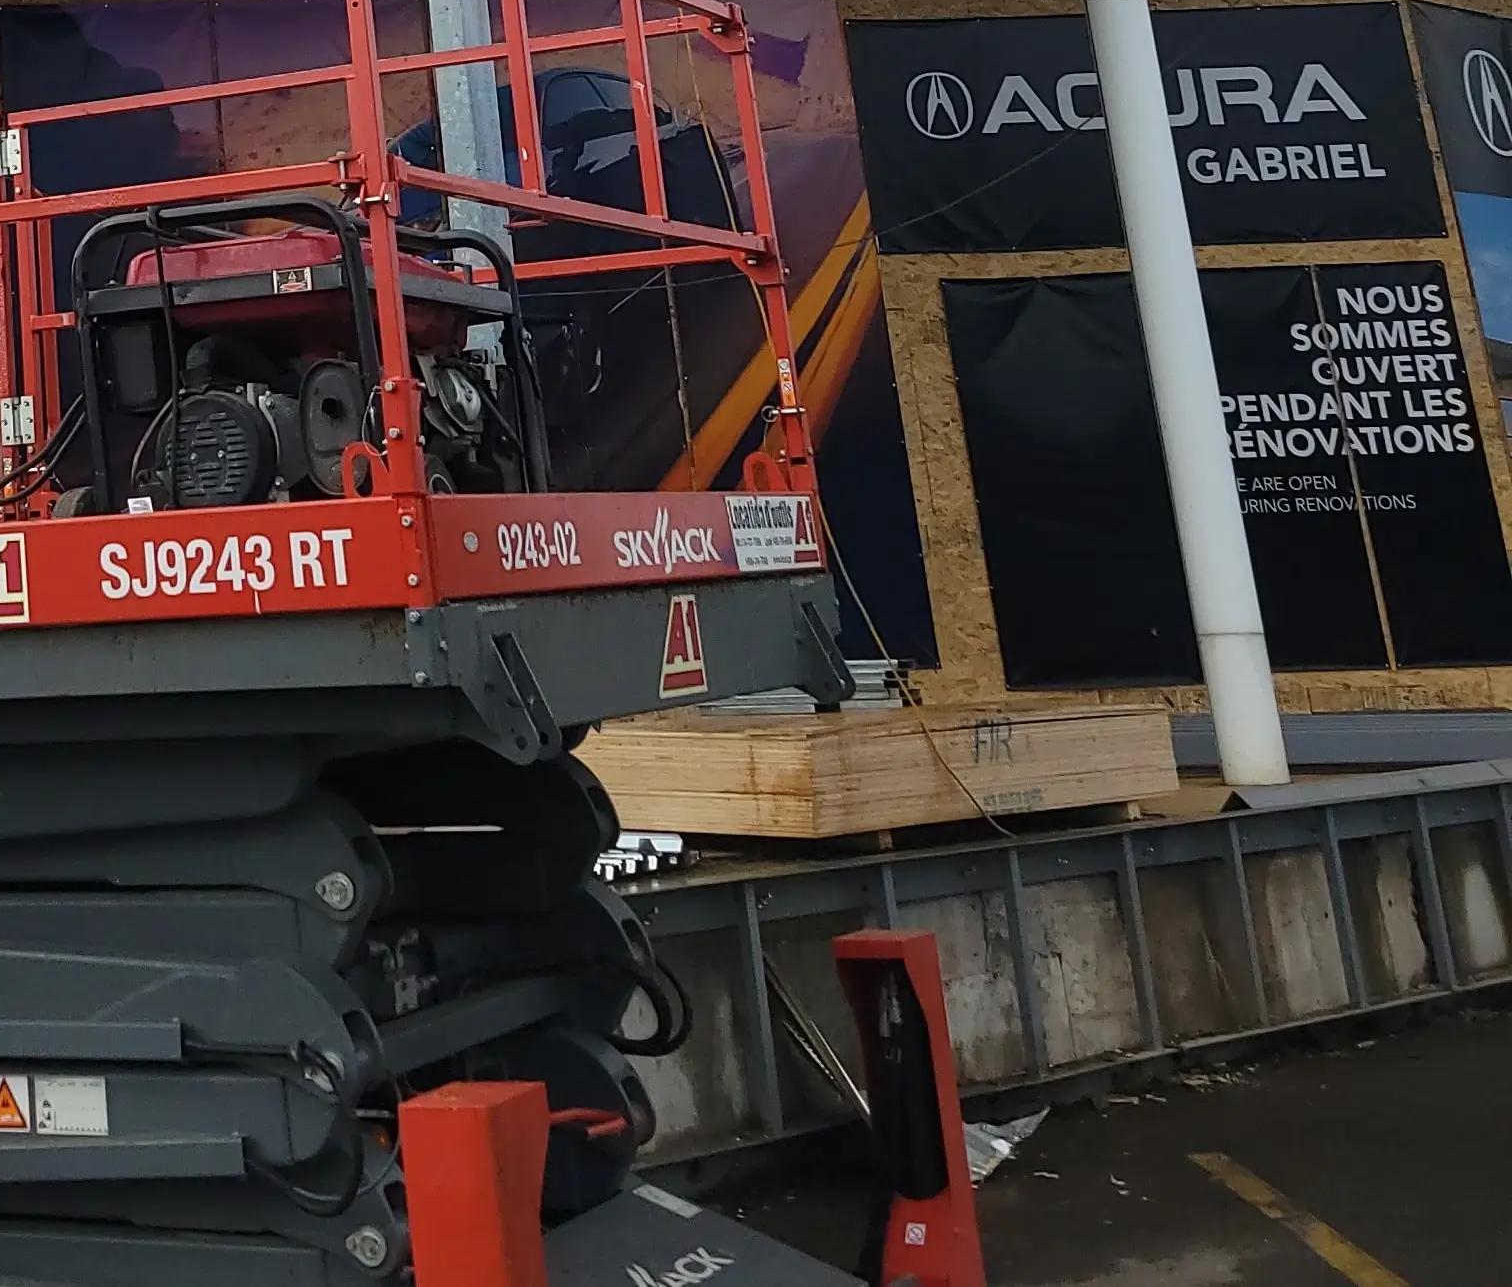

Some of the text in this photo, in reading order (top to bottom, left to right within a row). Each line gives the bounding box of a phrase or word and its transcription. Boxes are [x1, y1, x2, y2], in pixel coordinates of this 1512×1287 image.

[1188, 143, 1387, 184] GABRIEL
[1337, 284, 1444, 315] NOUS
[1290, 318, 1452, 352] SOMMES
[1311, 353, 1457, 386] OUVERT
[1403, 388, 1468, 418] LES
[1226, 423, 1475, 459] ÉNOVATIONS
[1236, 475, 1338, 492] E ARE OPEN
[1240, 494, 1417, 514] URING RENOVTIONS
[497, 506, 722, 574] 9243-02 SKYJACK
[99, 528, 353, 599] SJ9243 RT
